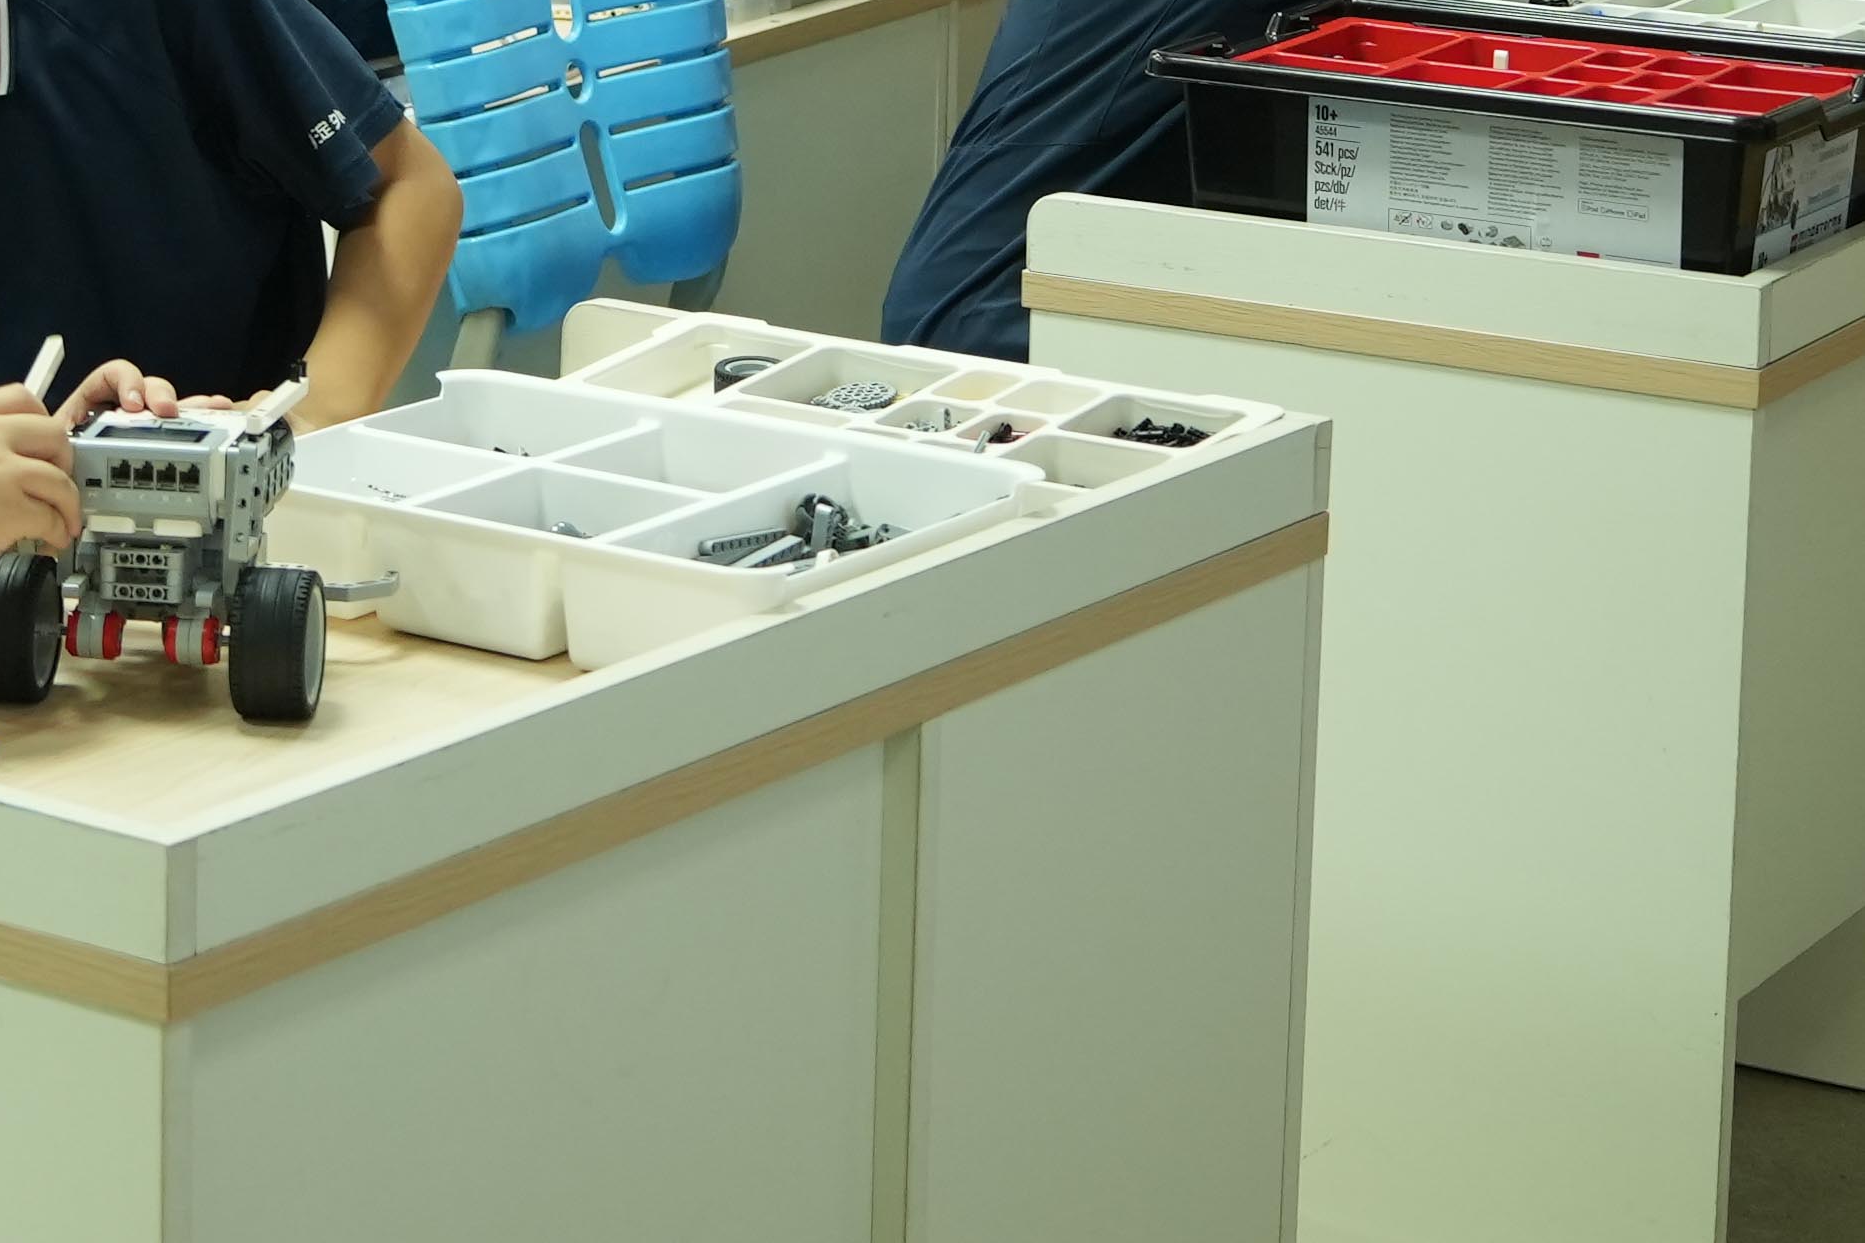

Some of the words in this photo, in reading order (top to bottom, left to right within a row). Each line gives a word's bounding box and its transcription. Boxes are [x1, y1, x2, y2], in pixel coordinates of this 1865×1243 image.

[1315, 104, 1338, 121] 10+
[1315, 140, 1334, 157] 541
[1338, 146, 1360, 162] pcs/
